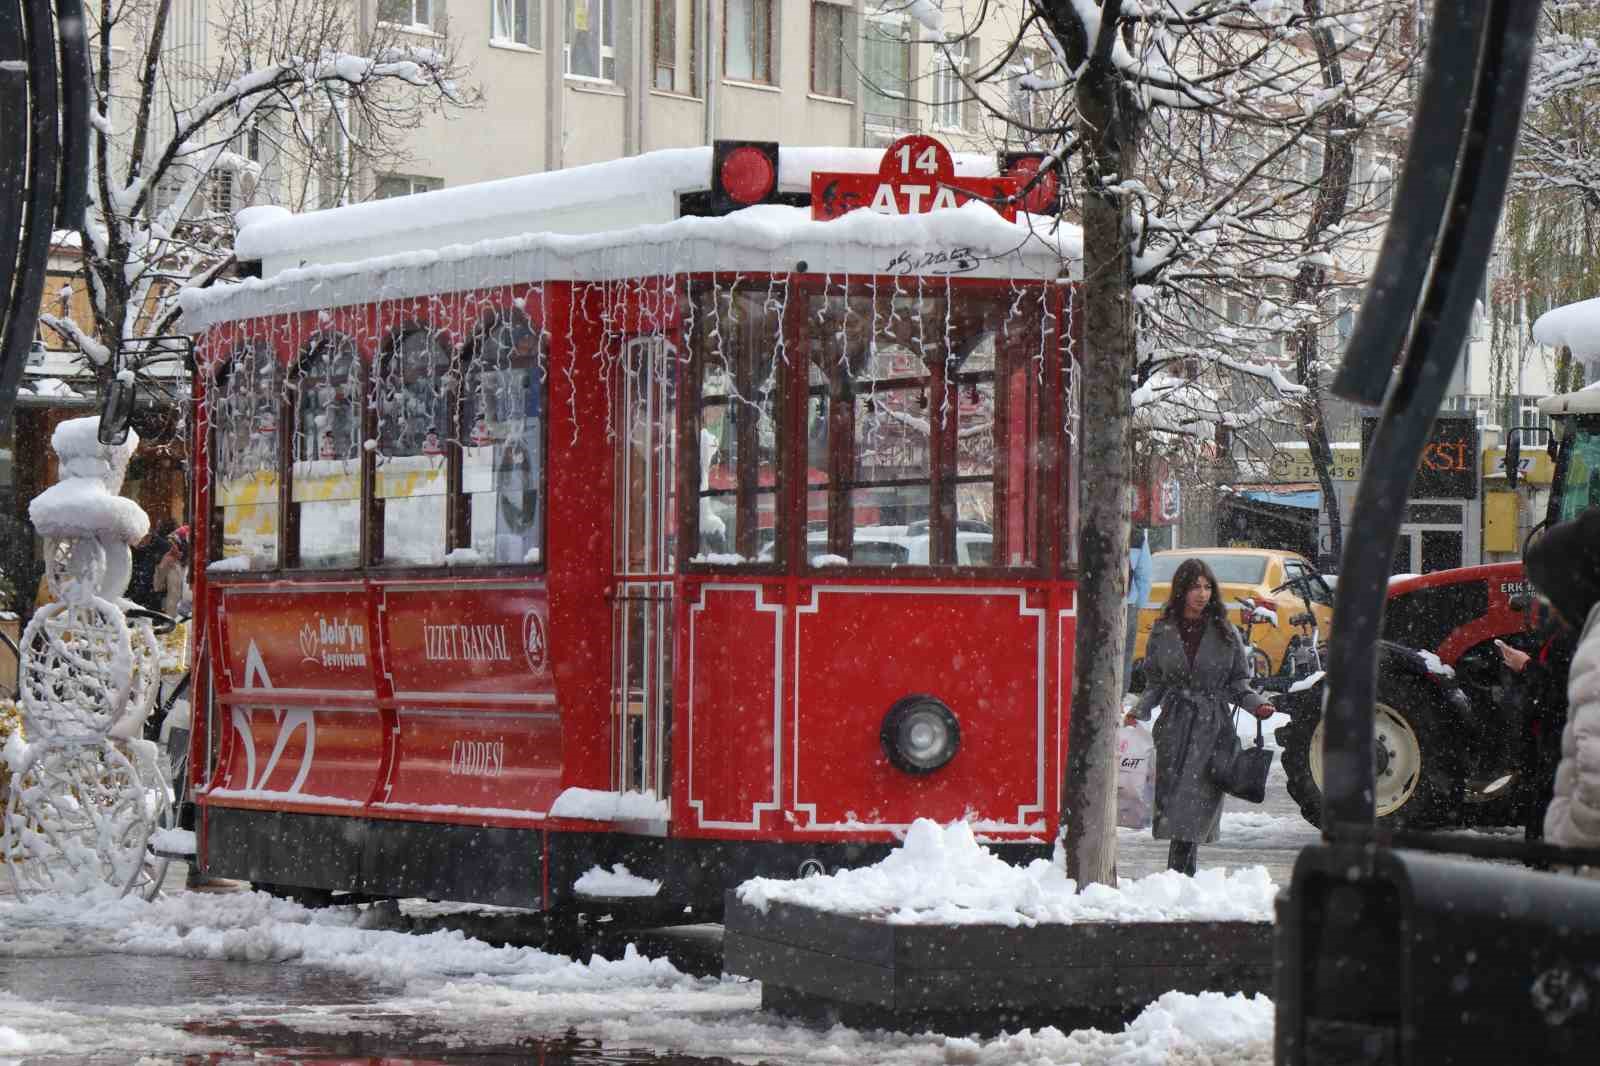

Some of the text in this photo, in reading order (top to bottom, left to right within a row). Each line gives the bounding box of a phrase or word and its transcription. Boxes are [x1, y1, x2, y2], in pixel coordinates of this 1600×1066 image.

[895, 144, 939, 175] 14
[870, 183, 958, 215] ATA
[423, 618, 511, 660] İZZET BAYSAL
[450, 736, 504, 776] CADDESİ
